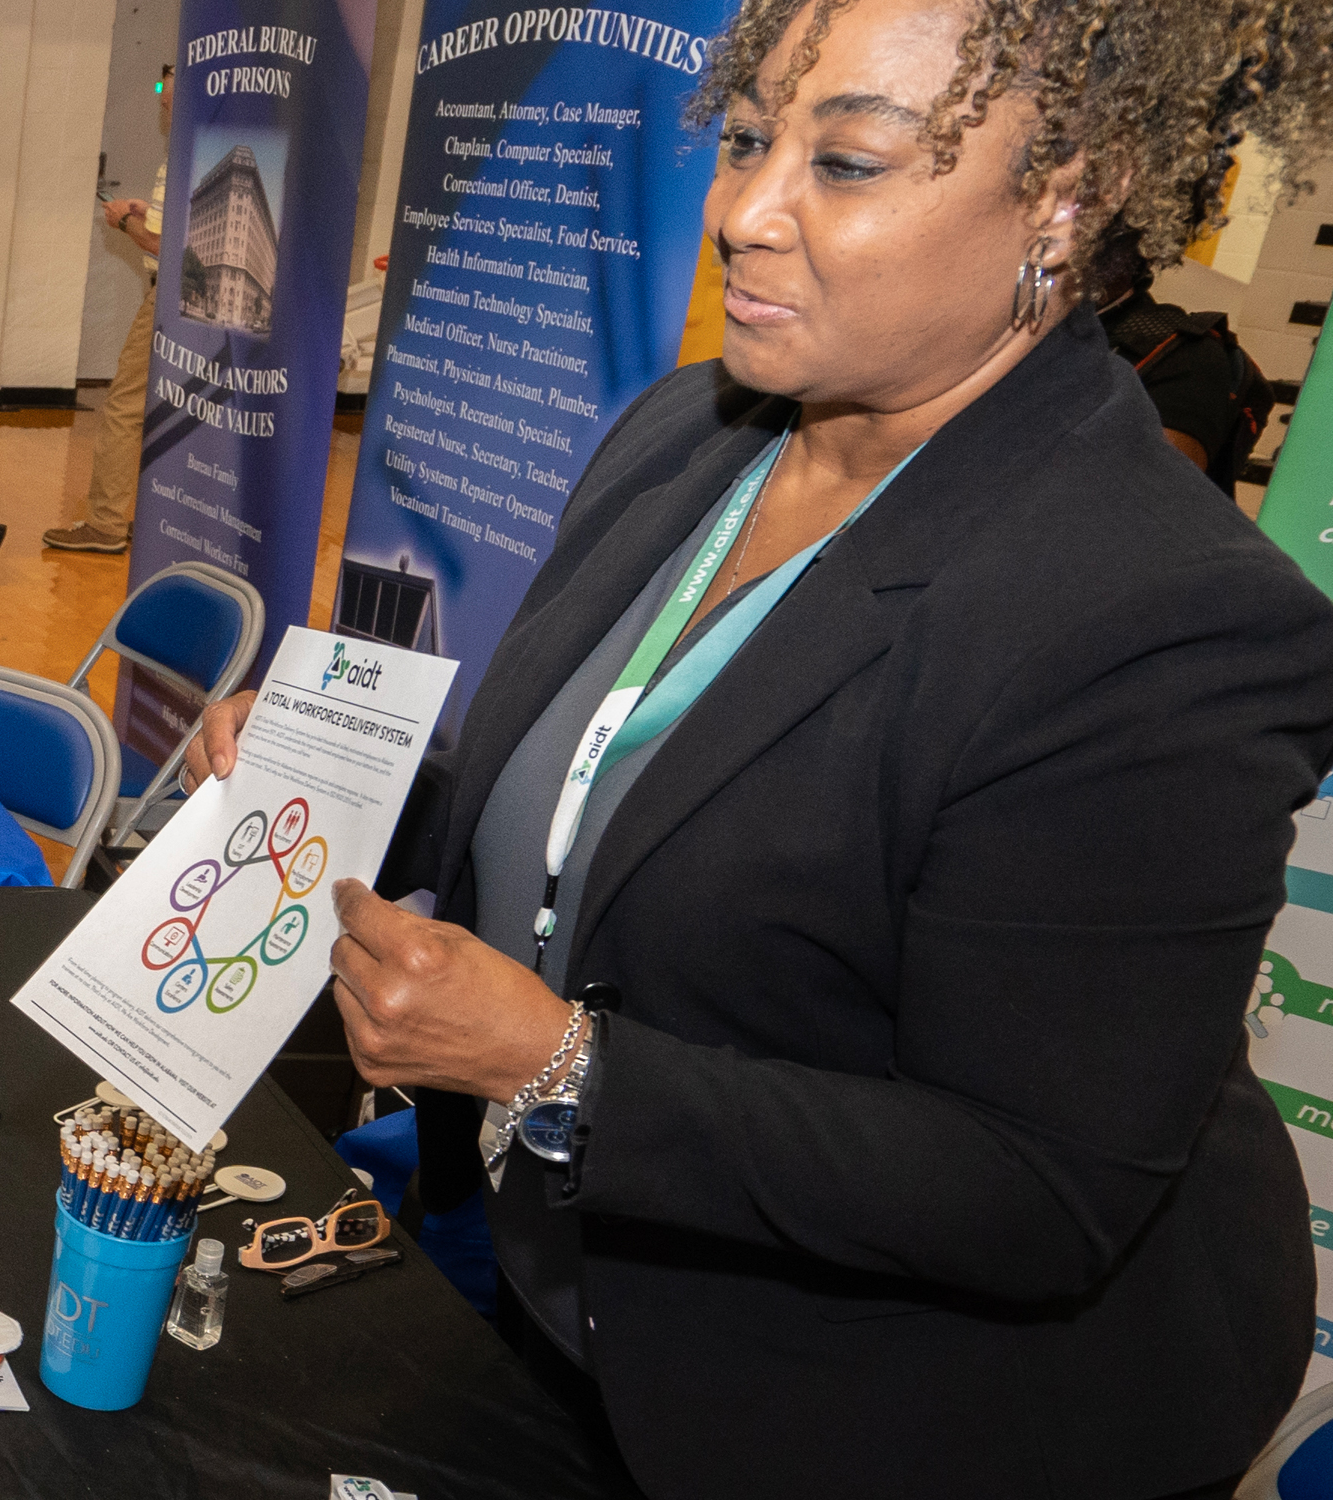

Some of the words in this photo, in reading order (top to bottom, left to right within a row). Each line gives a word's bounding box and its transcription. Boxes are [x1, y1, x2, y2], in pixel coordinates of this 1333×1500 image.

[187, 26, 257, 67] FEDERAL
[259, 25, 318, 65] BUREAU
[416, 17, 499, 75] CAREER
[504, 7, 708, 75] OPPORTUNITIES
[206, 68, 230, 97] OF
[232, 66, 291, 99] PRISONS
[435, 100, 496, 121] Accountant,
[499, 100, 549, 126] Attorney,
[553, 101, 582, 123] Case
[584, 102, 641, 130] Manager,
[445, 136, 493, 161] Chaplain,
[496, 139, 551, 165] Computer
[553, 142, 614, 168] Specialist,
[443, 173, 507, 198] Correctional
[510, 179, 552, 203] Officer,
[555, 183, 601, 210] Dentist,
[403, 205, 450, 232] Employee
[452, 212, 495, 236] Services
[497, 217, 554, 247] Specialist,
[557, 225, 588, 248] Food
[589, 229, 642, 260] Service,
[426, 245, 461, 268] Health
[462, 250, 524, 280] Information
[526, 260, 590, 295] Technician,
[412, 278, 470, 308] Information
[472, 290, 534, 325] Technology
[535, 303, 594, 336] Specialist,
[154, 330, 222, 387] CULTURAL
[224, 366, 288, 395] ANCHORS
[404, 313, 445, 339] Medical
[446, 321, 484, 350] Officer,
[487, 332, 519, 358] Nurse
[522, 340, 589, 378] Practitioner,
[155, 375, 185, 409] AND
[187, 392, 223, 429] CORE
[226, 407, 274, 437] VALUES
[386, 344, 440, 376] Pharmacist,
[442, 358, 492, 389] Physician
[493, 374, 545, 407] Assistant,
[547, 387, 599, 421] Plumber,
[393, 381, 457, 418] Psychologist,
[459, 400, 515, 434] Recreation
[516, 418, 573, 457] Specialist,
[187, 453, 212, 477] Bureau
[212, 464, 239, 491] Family
[384, 414, 436, 446] Registered
[437, 430, 469, 459] Nurse,
[471, 442, 522, 480] Secretary,
[526, 460, 570, 497] Teacher,
[152, 478, 176, 501] Sound
[178, 488, 219, 519] Correctional
[221, 507, 262, 543] Management
[385, 449, 417, 479] Utility
[418, 461, 458, 491] Systems
[460, 476, 505, 509] Repairer
[506, 494, 555, 533] Operator,
[160, 519, 202, 552] Correctional
[204, 539, 232, 567] Workers
[233, 555, 249, 577] First
[390, 485, 439, 520] Vocational
[441, 505, 483, 542] Training
[485, 523, 537, 564] Instructor,
[678, 469, 767, 604] www.aidt.edu
[347, 658, 382, 691] aidt
[263, 691, 269, 703] A
[268, 692, 290, 710] TOTAL
[292, 698, 342, 728] WORKFORCE
[342, 714, 383, 738] DELIVERY
[378, 726, 414, 749] SYSTEM
[587, 723, 612, 760] aidt
